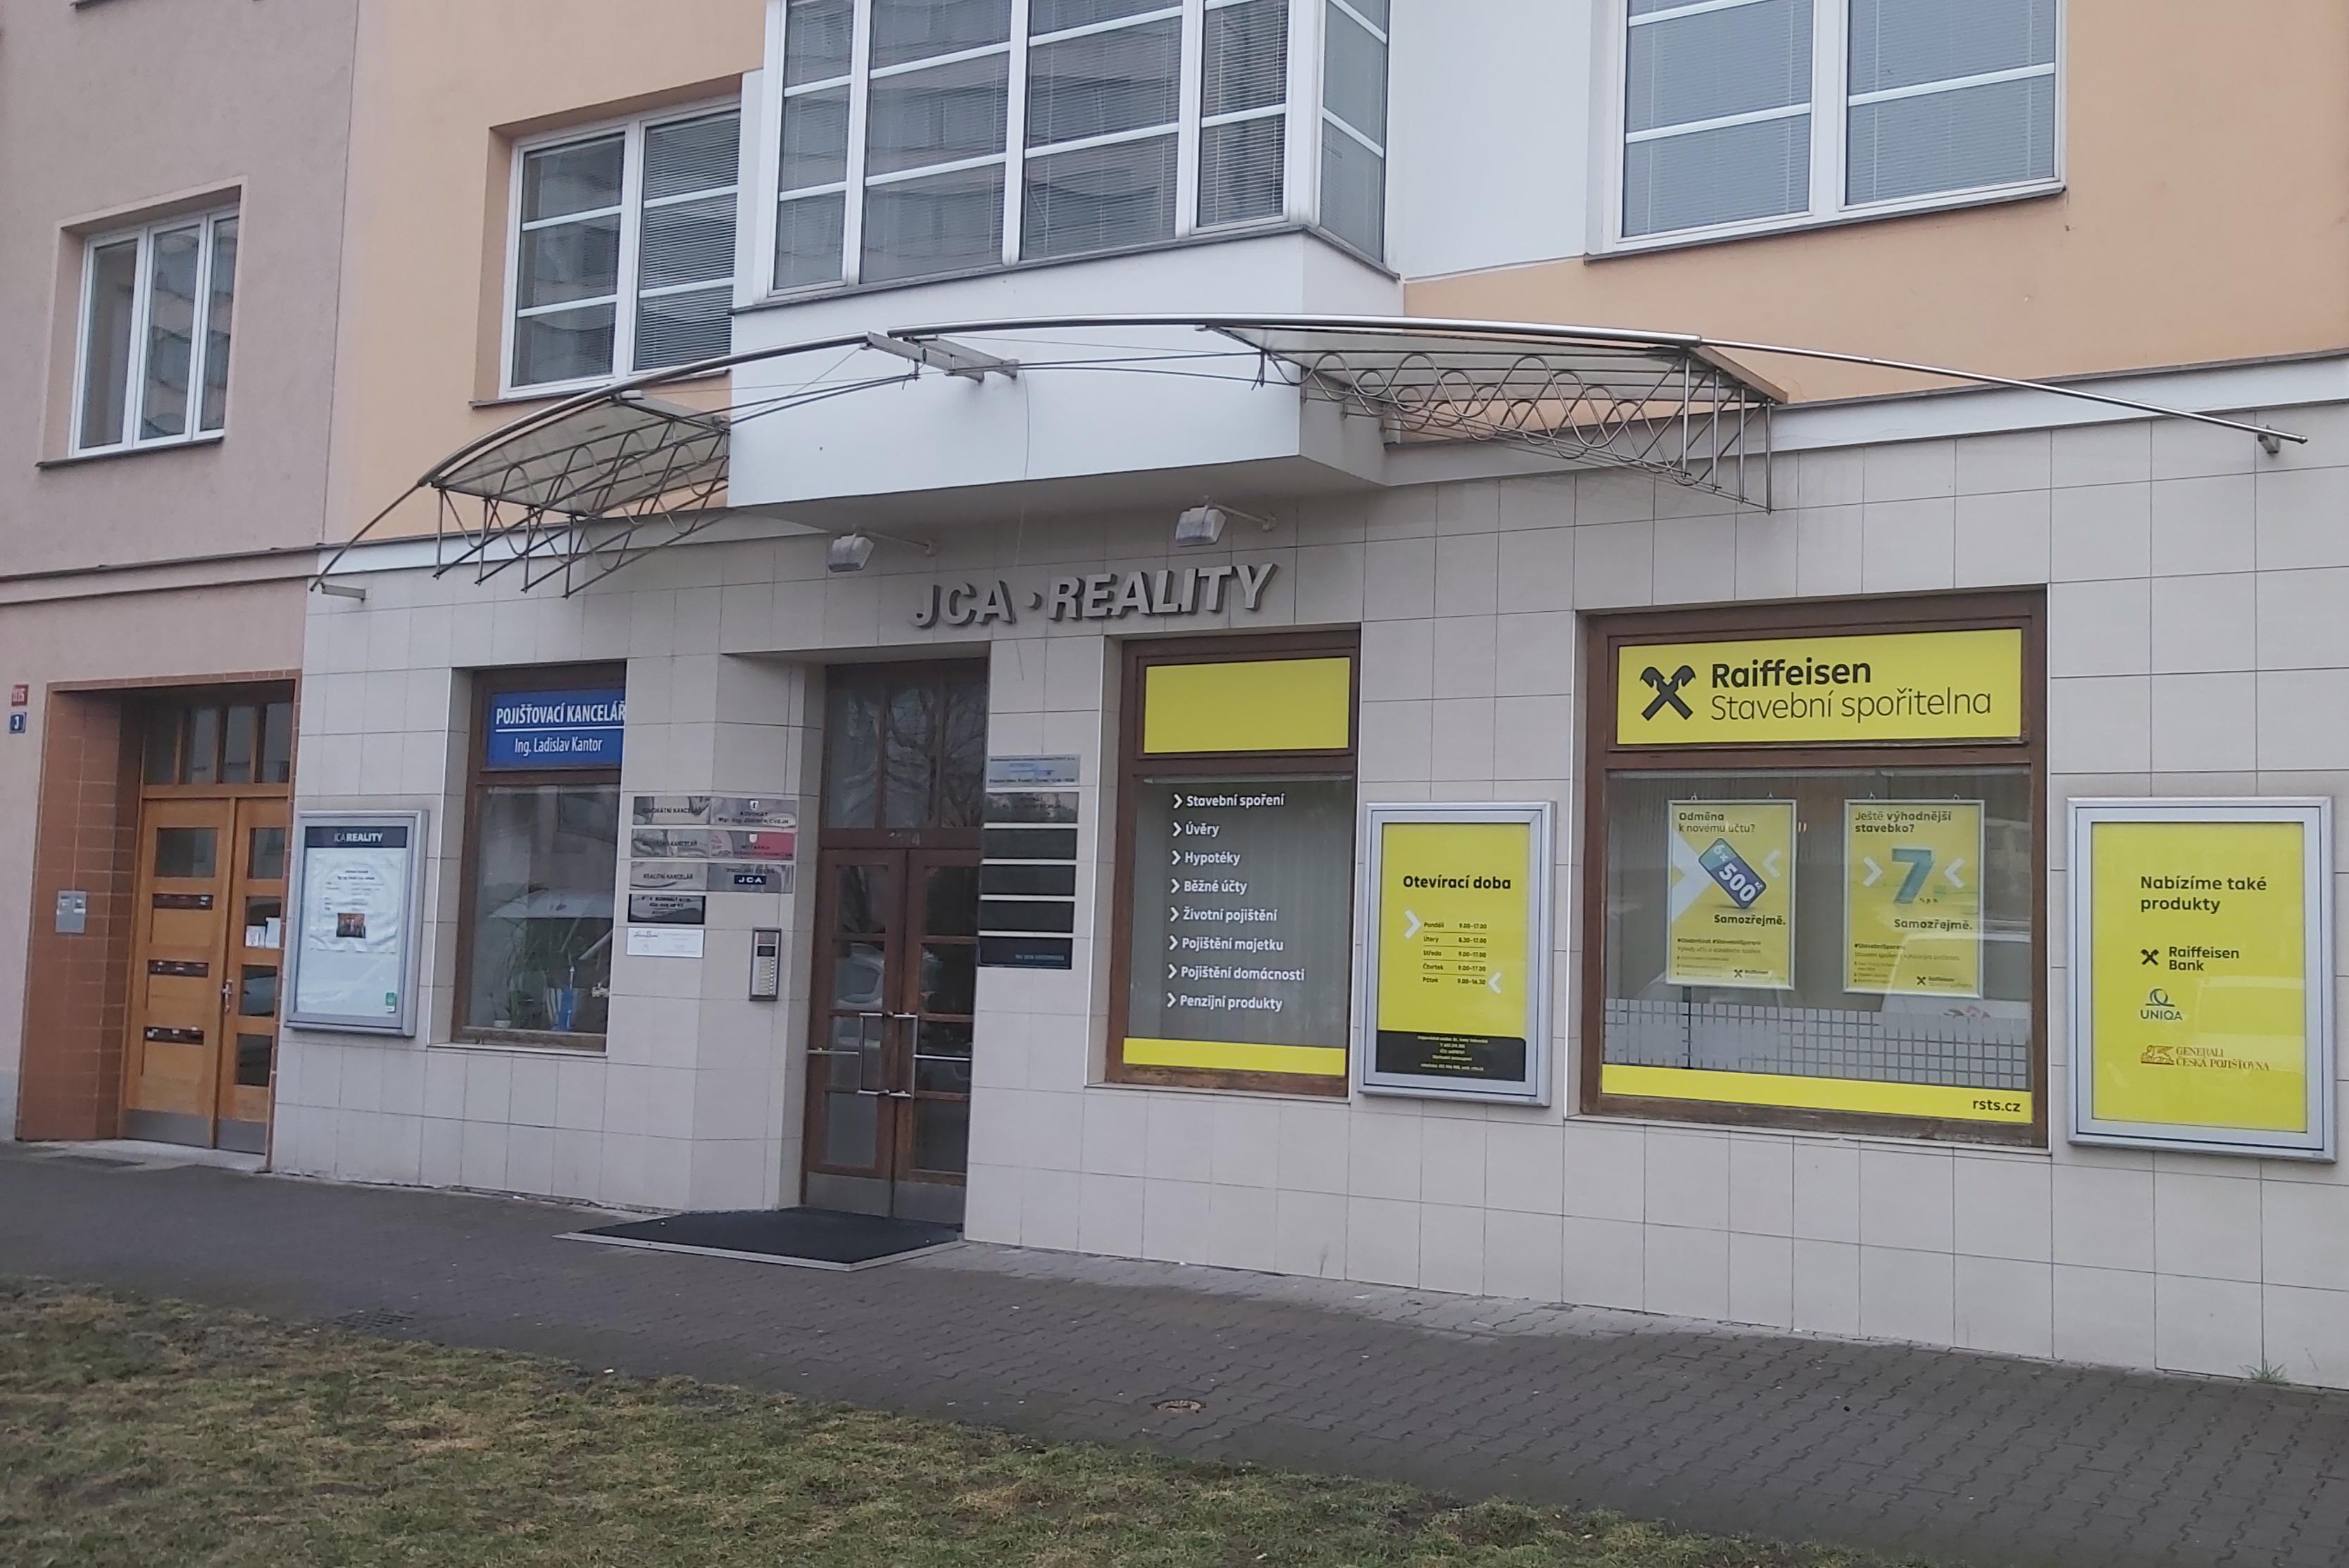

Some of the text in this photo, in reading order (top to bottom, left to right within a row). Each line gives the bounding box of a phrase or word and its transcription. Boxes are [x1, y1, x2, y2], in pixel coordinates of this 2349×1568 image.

[913, 563, 1277, 627] JCA REALITY
[1712, 656, 1872, 688] Raiffeisen
[1711, 687, 1991, 723] Stavební spořitelna
[496, 703, 565, 725] POJIŠŤOVACÍ
[515, 736, 603, 756] Ing. Ladislav Kantor
[1186, 793, 1285, 808] Stavební spoření
[1679, 811, 1724, 821] Odměna
[1855, 810, 1952, 823] Ještě výhodnější
[1184, 821, 1220, 837] Úvěry
[1678, 823, 1755, 833] k novému účtu?
[1855, 823, 1915, 833] stavebko?
[1184, 851, 1241, 866] Hypotéky
[1403, 874, 1512, 889] Otevírací doba
[1719, 863, 1756, 901] 500
[1891, 848, 1935, 904] 7
[2140, 875, 2267, 891] Nabízíme také
[1184, 879, 1248, 895] Běžné účty
[2140, 896, 2221, 914] produkty
[1183, 905, 1278, 924] Životní pojištění
[1714, 914, 1786, 927] Samozřejmě.
[1894, 918, 1974, 931] Samozřejmě.
[1182, 936, 1284, 953] Pojištění majetku
[2169, 946, 2240, 960] Raiffeisen
[1181, 965, 1306, 981] Pojištění domácnosti
[2169, 959, 2204, 972] Bank
[1179, 994, 1283, 1012] Penzijní produkty
[2141, 1009, 2183, 1021] UNIQA
[2176, 1046, 2224, 1058] GENERALI
[1972, 1098, 2021, 1112] rsts.cz
